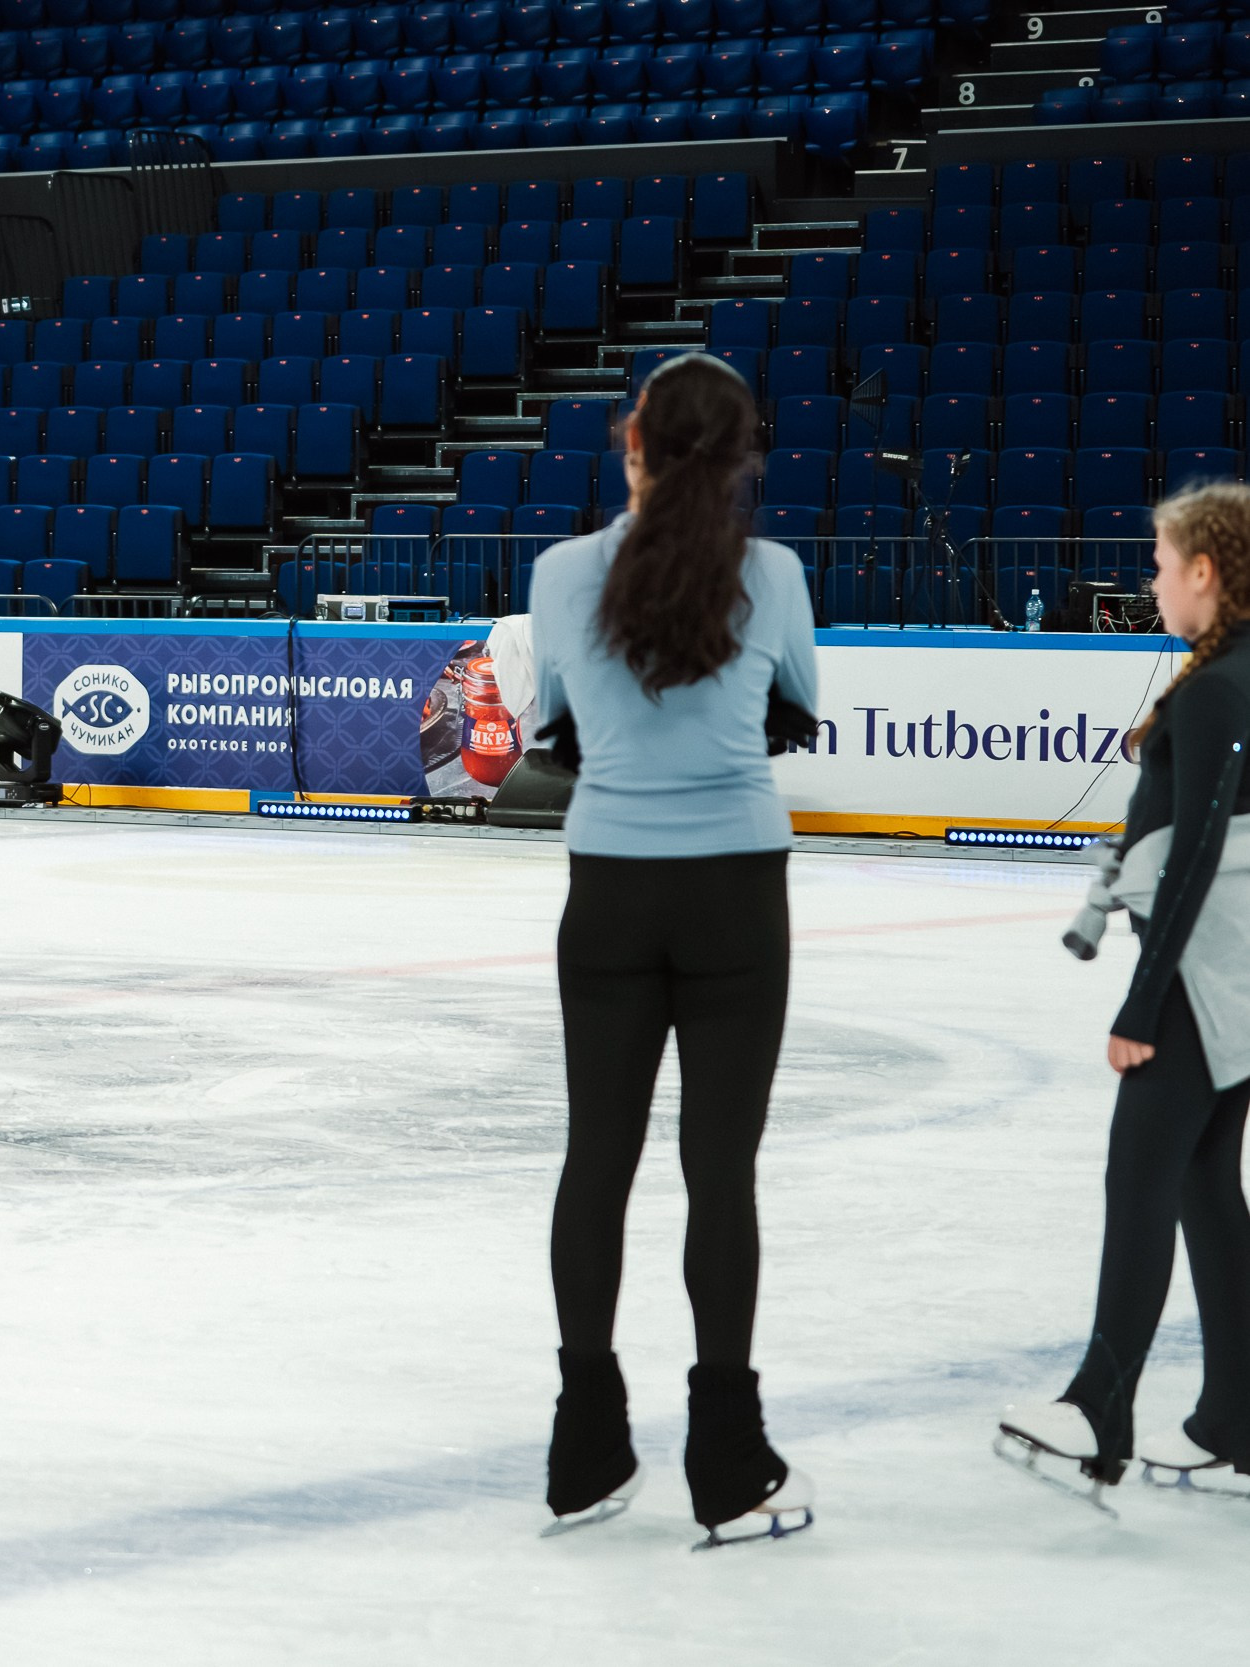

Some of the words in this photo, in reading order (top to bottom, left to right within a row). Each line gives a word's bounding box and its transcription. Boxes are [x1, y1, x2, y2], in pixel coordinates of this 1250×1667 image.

[1027, 17, 1043, 39] 9
[959, 82, 975, 104] 8
[892, 147, 908, 171] 7
[73, 672, 129, 692] СОНИКО
[168, 673, 413, 699] РЫБОПРОМЫСЛОВАЯ
[70, 722, 135, 746] ЧУМИКАН
[469, 728, 515, 746] ИКРА
[168, 738, 248, 751] ОХОТСКОЕ
[256, 741, 294, 753] МОР
